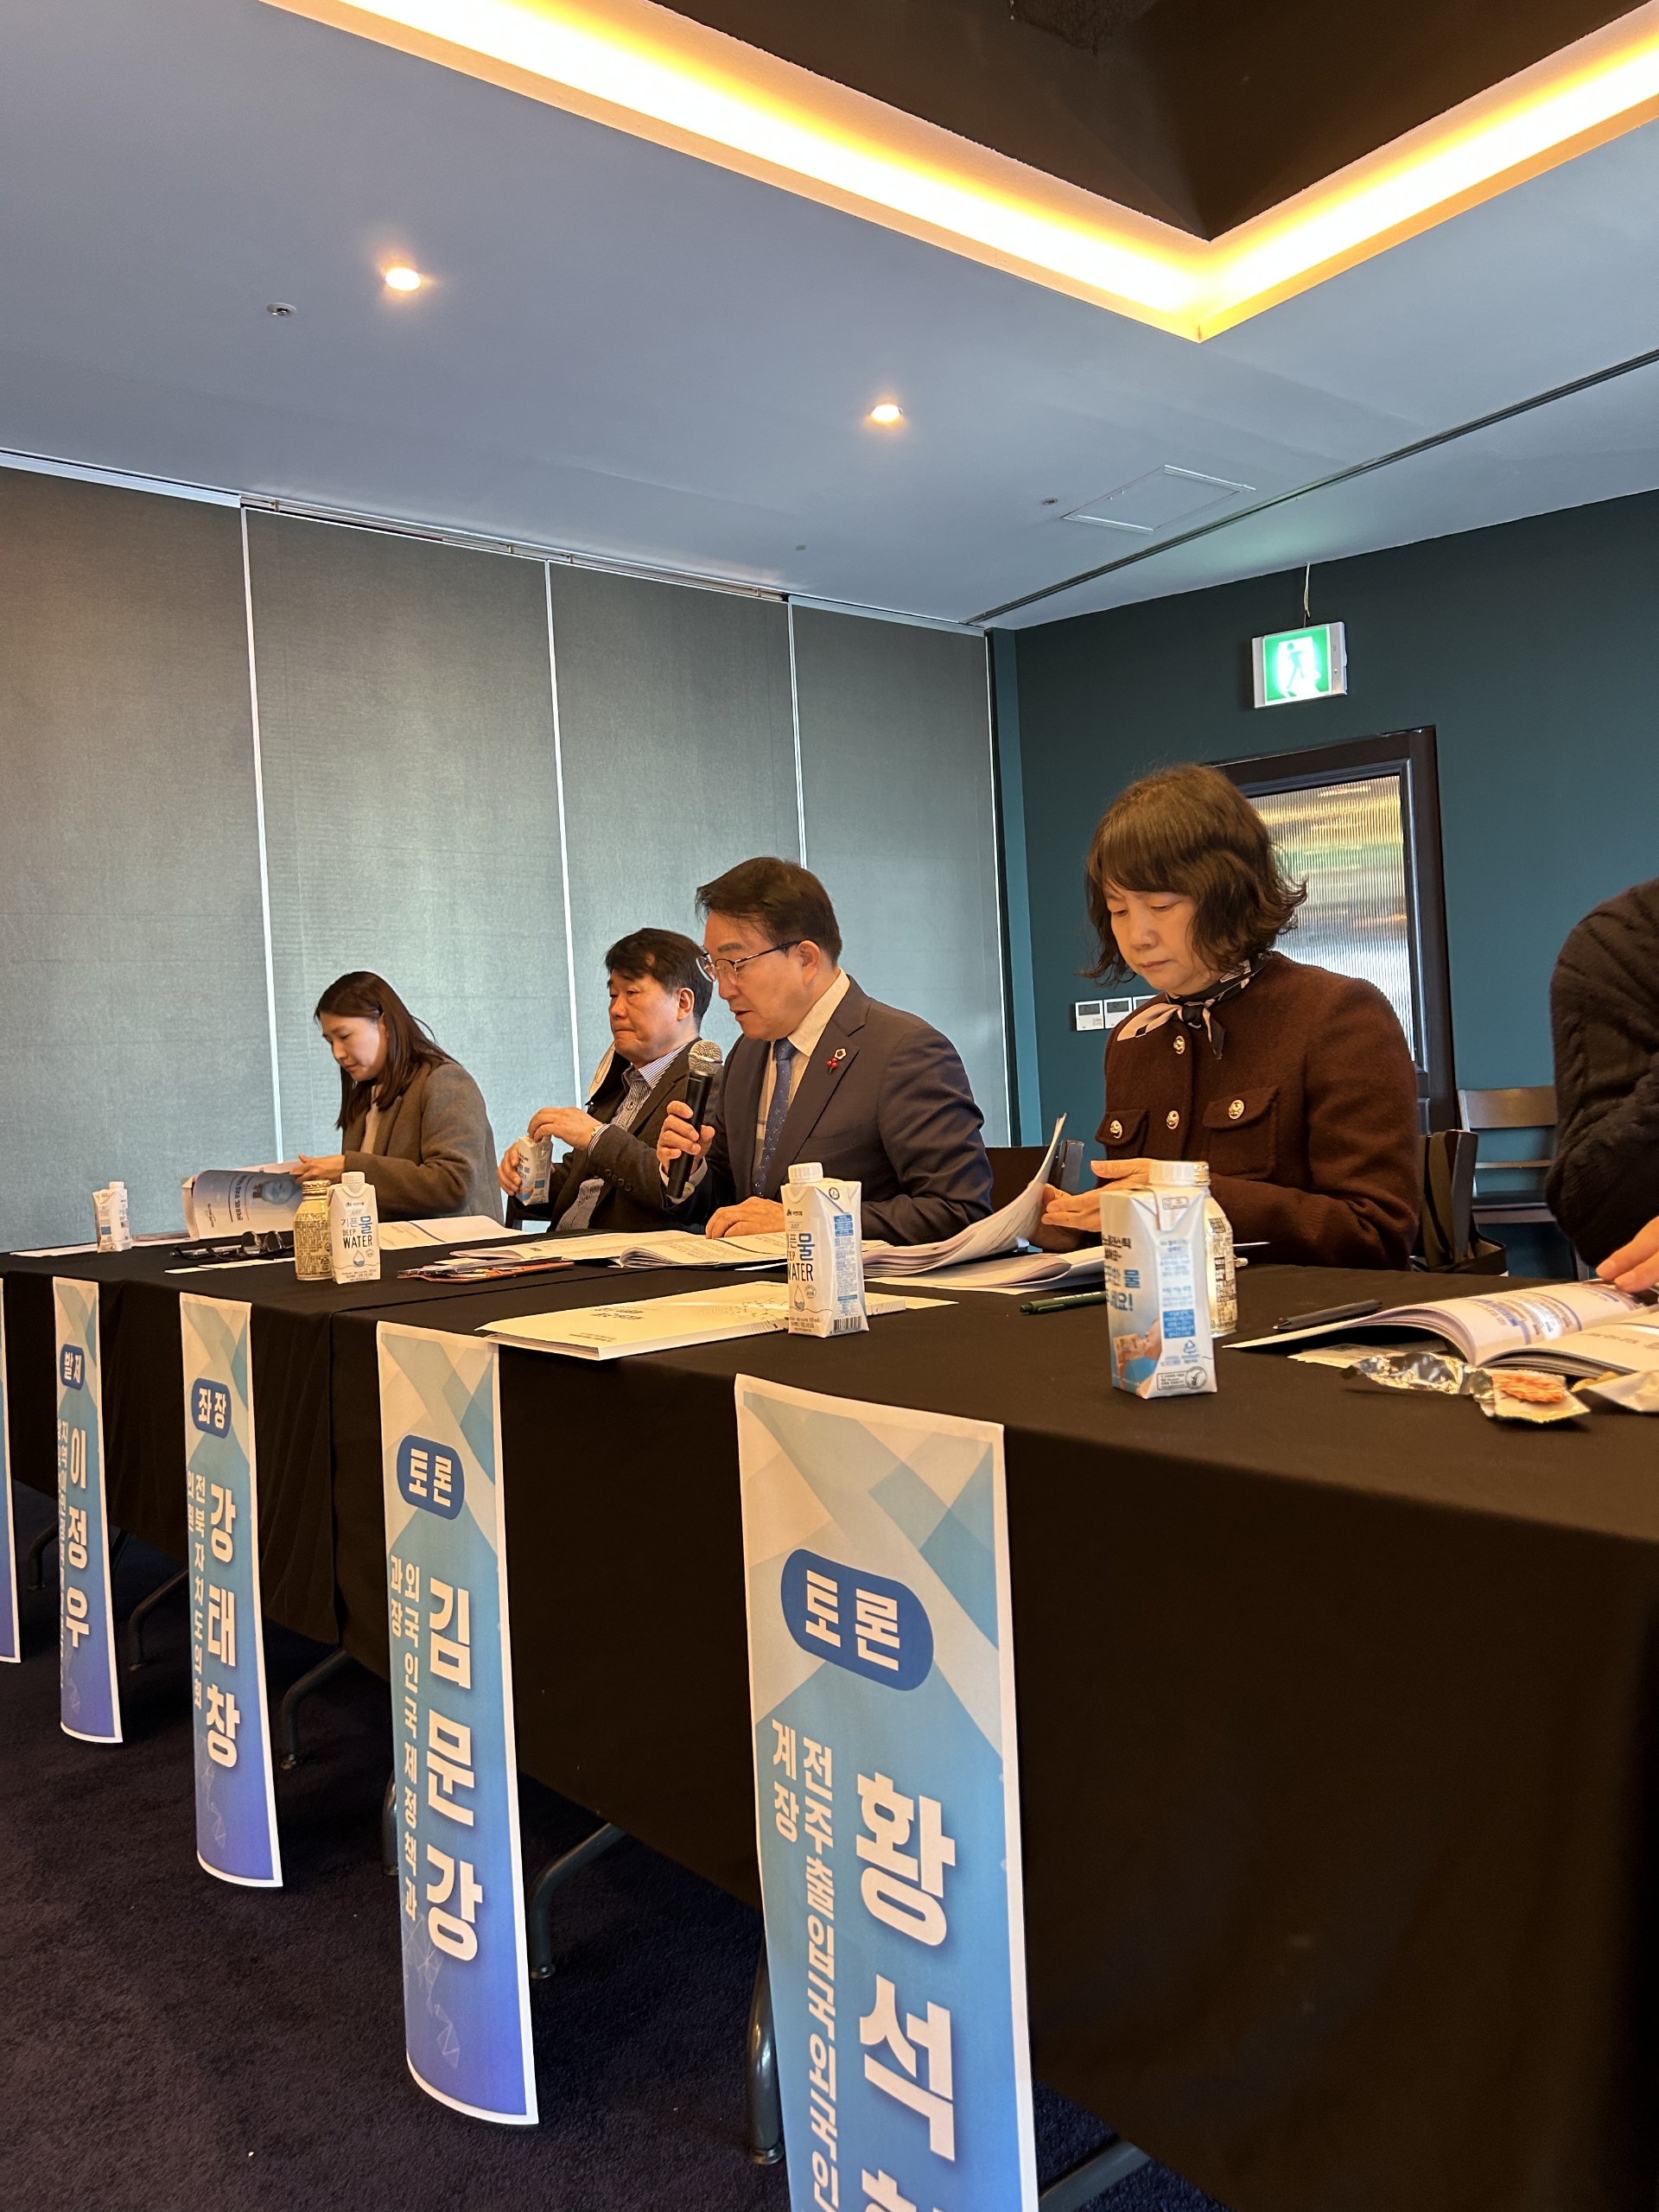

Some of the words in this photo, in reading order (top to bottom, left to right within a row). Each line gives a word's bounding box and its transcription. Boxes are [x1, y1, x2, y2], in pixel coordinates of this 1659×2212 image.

[343, 1235, 372, 1249] WATER
[359, 1216, 372, 1234] 물
[798, 1233, 815, 1261] 물
[198, 1388, 226, 1429] 좌장
[409, 1448, 452, 1507] 토론
[391, 1555, 403, 1638] 과장
[805, 1569, 900, 1671] 토론
[772, 1719, 800, 1842] 계장
[856, 1771, 957, 2211] 황석
